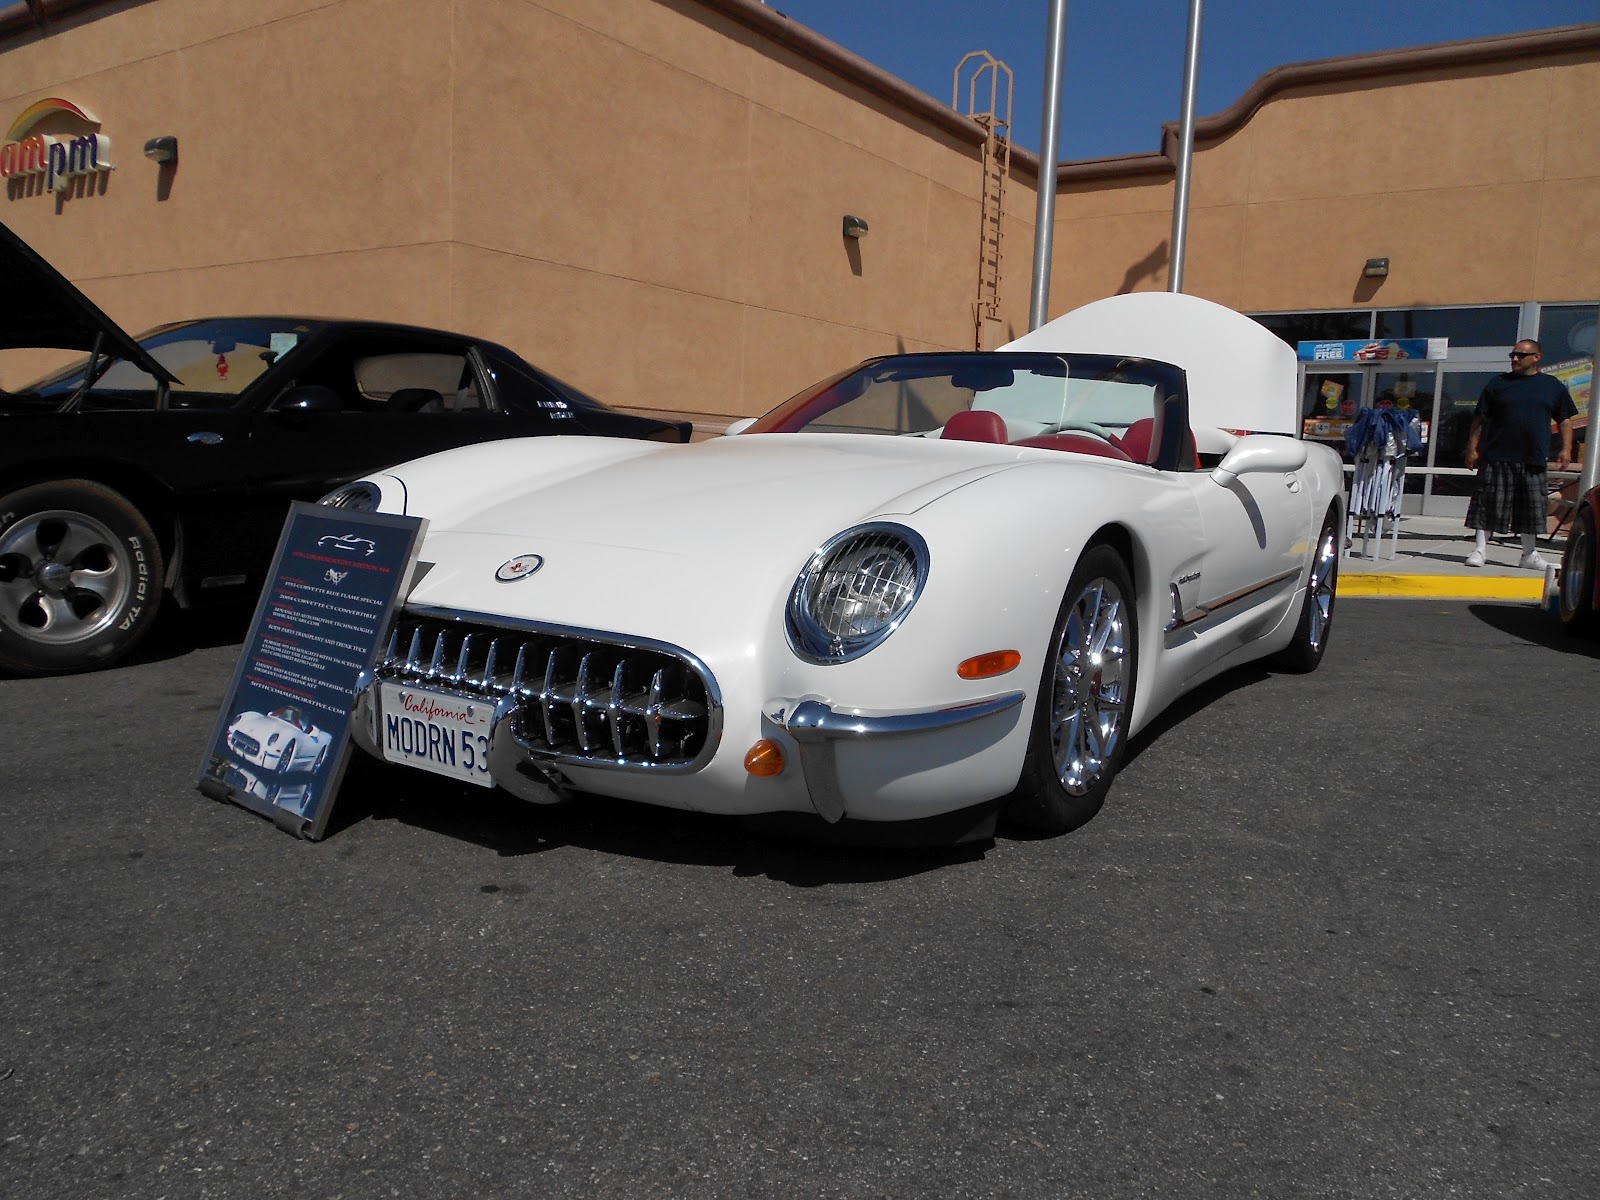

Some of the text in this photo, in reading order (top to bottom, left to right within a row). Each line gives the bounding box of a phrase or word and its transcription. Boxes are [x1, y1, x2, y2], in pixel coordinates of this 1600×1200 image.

[0, 133, 109, 193] ampm
[1316, 350, 1342, 360] FREE
[1541, 364, 1558, 372] CAR
[118, 536, 148, 631] Radial T/A
[295, 583, 325, 593] CORVETTE
[359, 597, 383, 605] SPECIAL
[293, 596, 325, 607] CORVETTE
[333, 606, 376, 619] CONVERTIBLE
[300, 613, 333, 624] AUTOMOTIVE
[333, 621, 373, 634] TECHNOLOGIES
[294, 630, 324, 642] TRANSPLANT
[335, 641, 353, 649] TRUNK
[405, 694, 474, 724] California
[387, 714, 488, 772] MODRN 53
